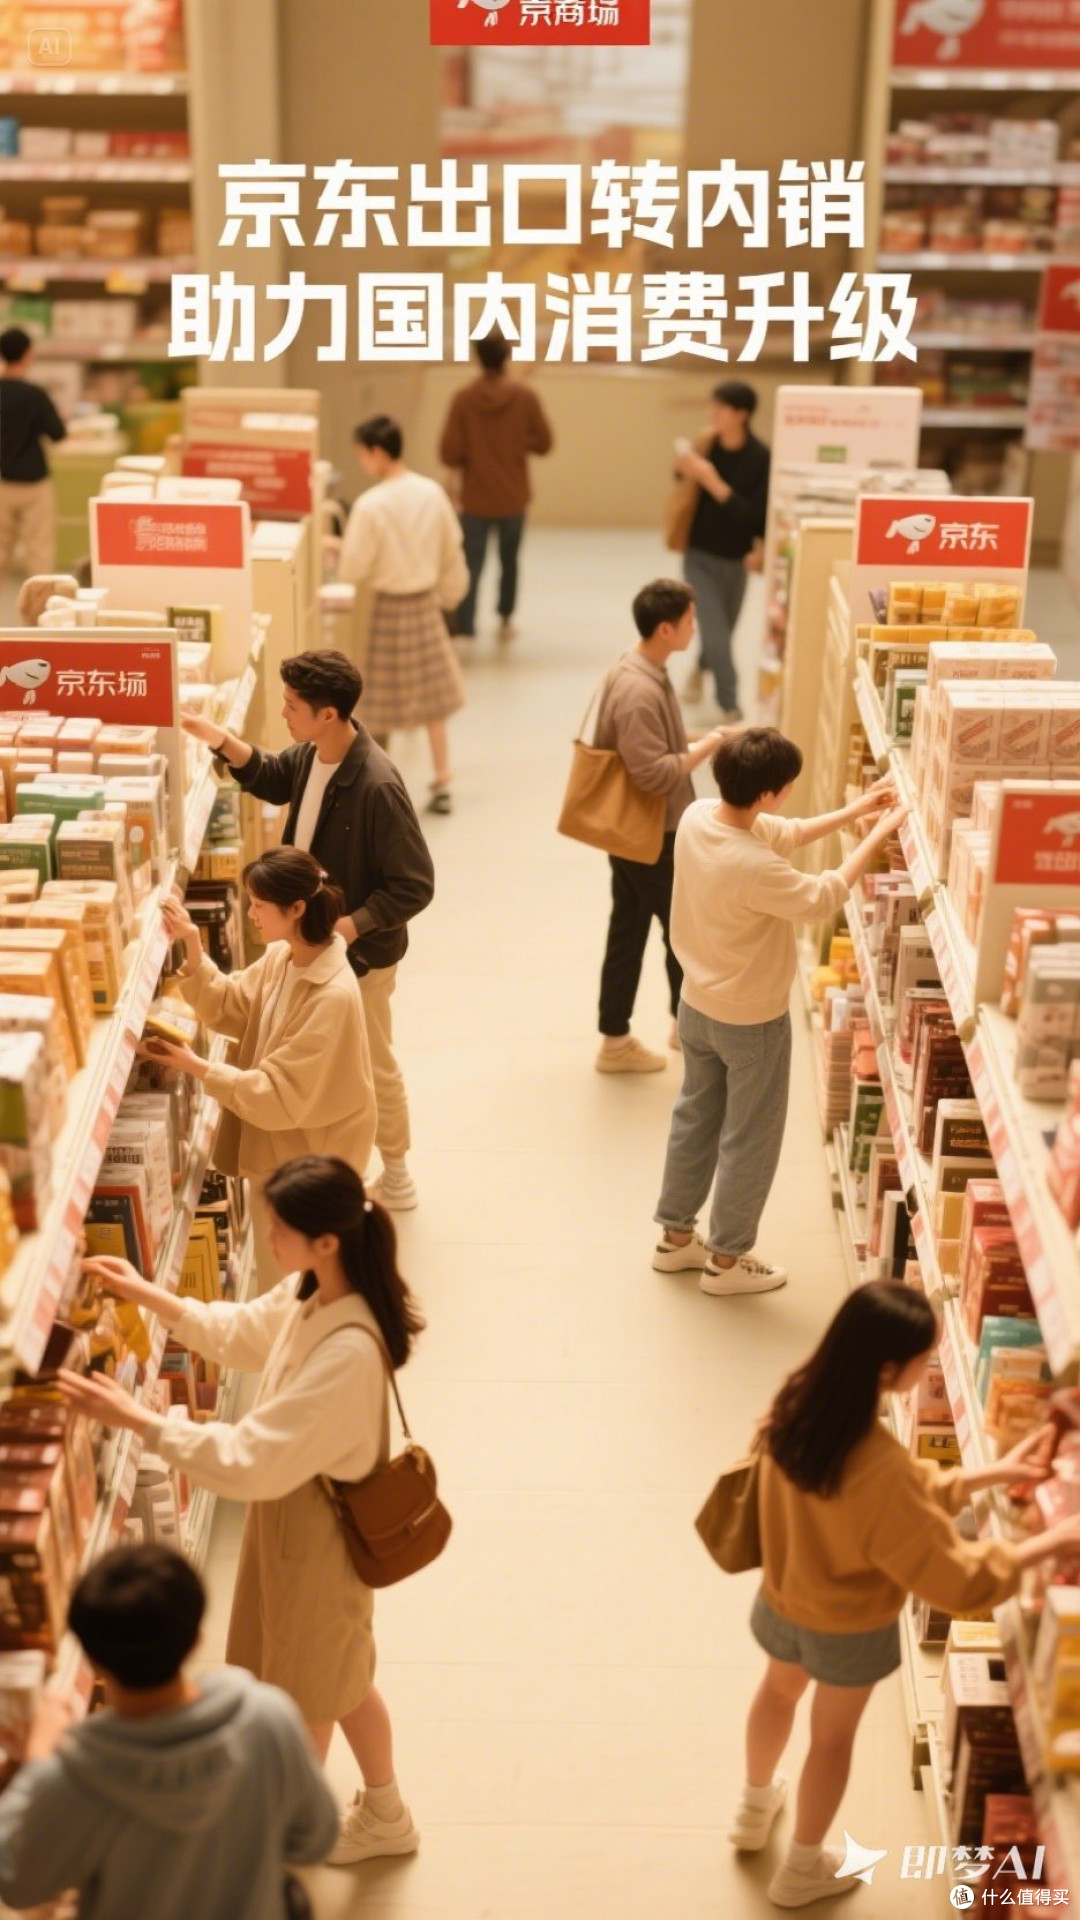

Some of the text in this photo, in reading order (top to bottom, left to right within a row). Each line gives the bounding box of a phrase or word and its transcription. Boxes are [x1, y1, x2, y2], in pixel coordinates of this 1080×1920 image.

[939, 522, 999, 550] 京东
[55, 669, 148, 697] 京东场
